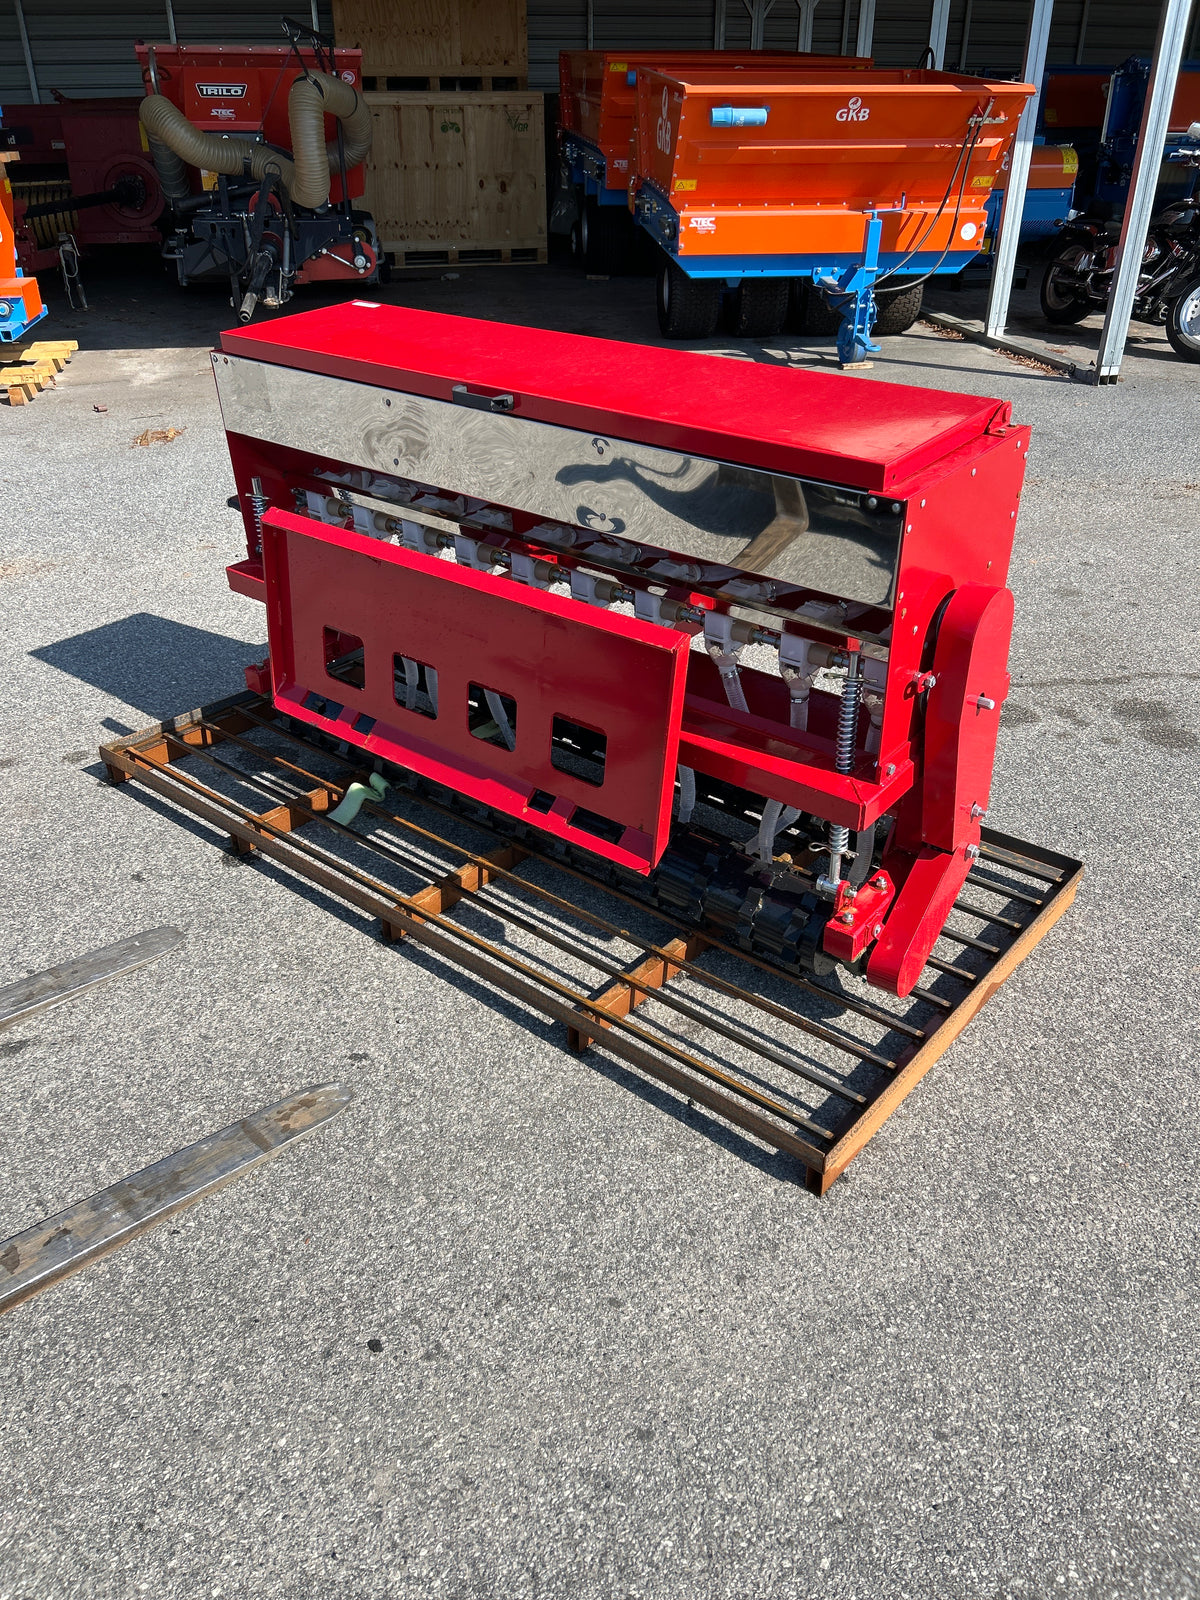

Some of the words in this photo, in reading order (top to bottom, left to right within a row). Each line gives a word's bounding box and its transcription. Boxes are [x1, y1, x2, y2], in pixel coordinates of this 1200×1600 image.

[199, 86, 244, 96] TRILO
[210, 108, 235, 116] STEC
[835, 107, 870, 122] GKB
[656, 116, 672, 155] GKB
[613, 159, 629, 168] STE
[688, 217, 716, 228] STEC
